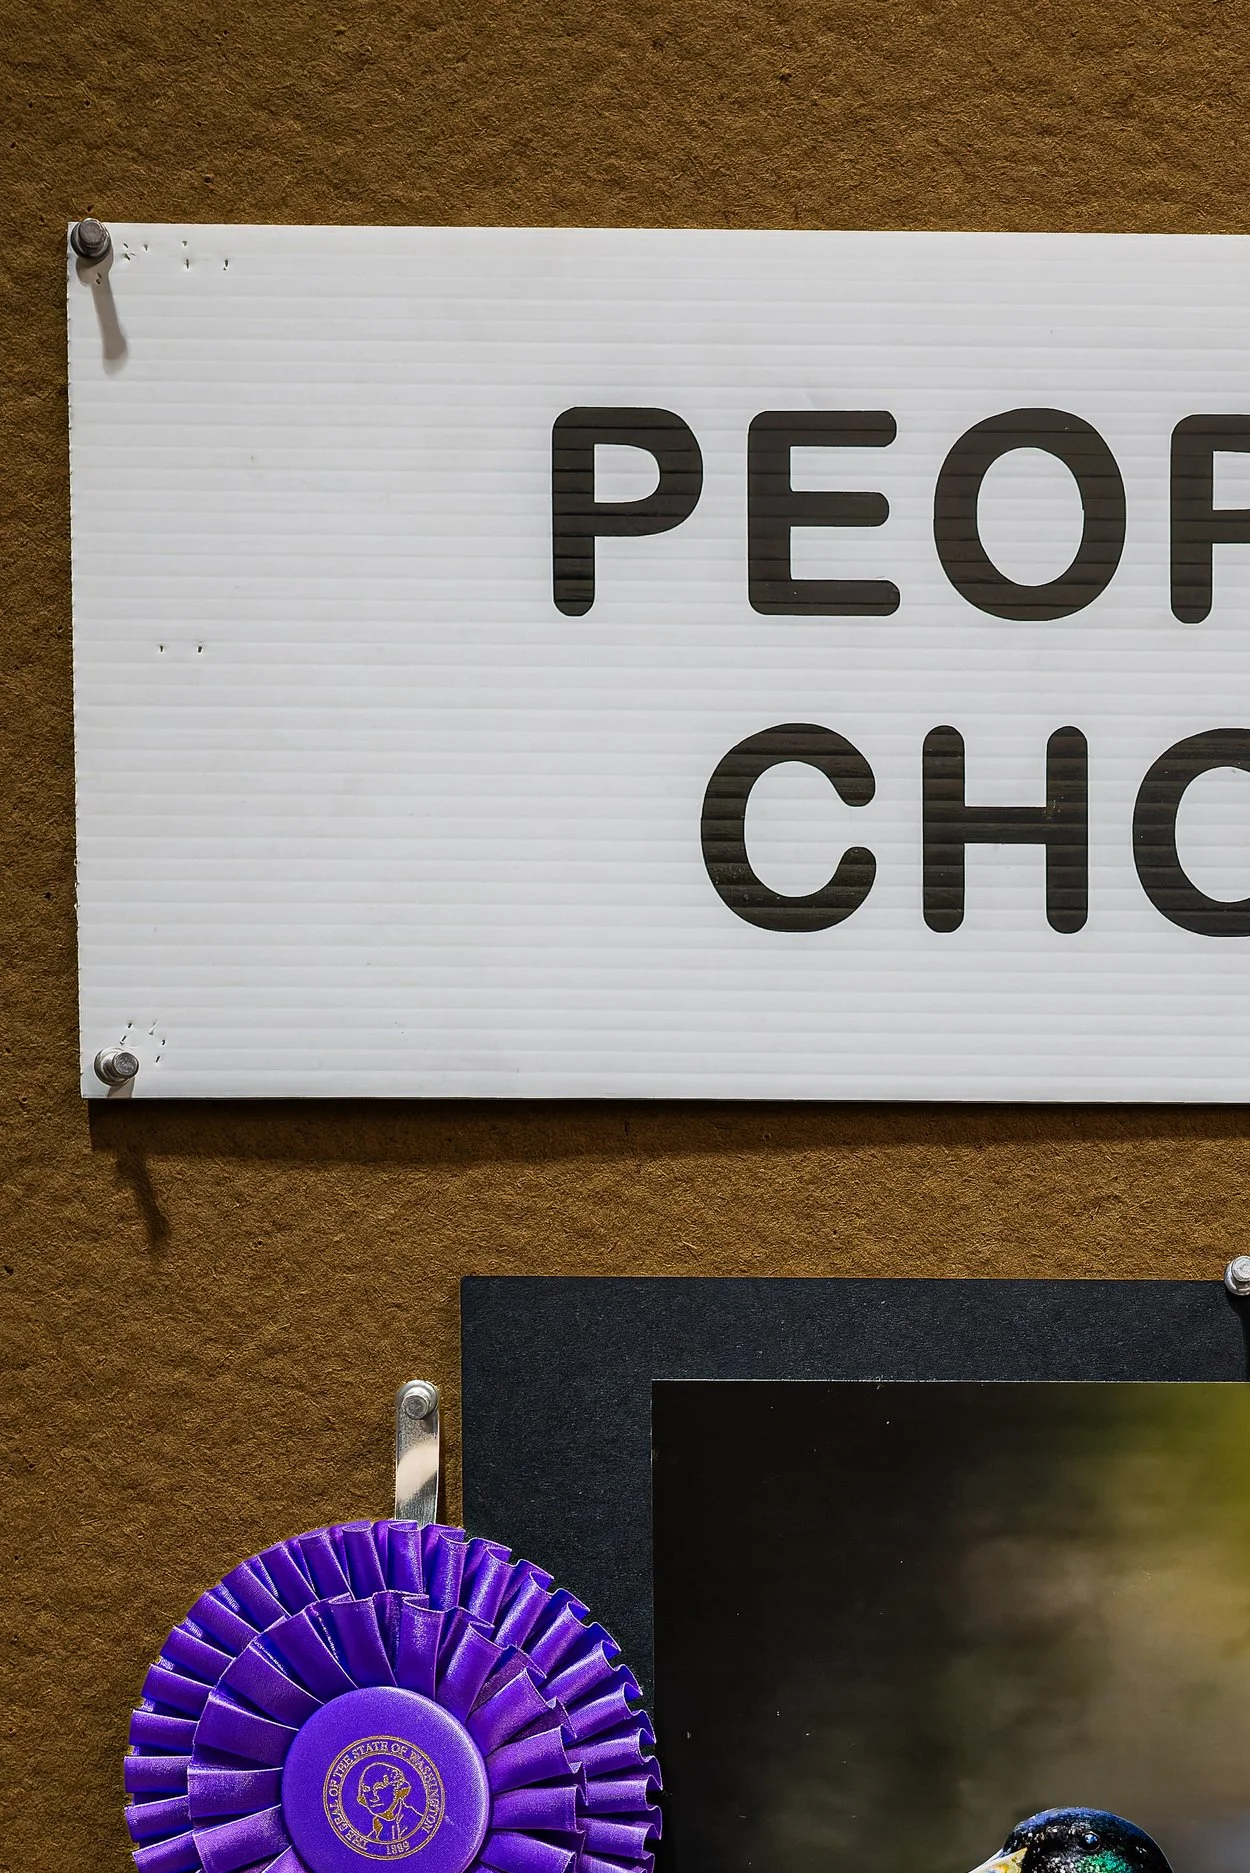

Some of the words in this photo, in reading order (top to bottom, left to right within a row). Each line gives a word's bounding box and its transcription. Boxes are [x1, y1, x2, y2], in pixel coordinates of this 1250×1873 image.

[352, 1741, 388, 1758] STATE
[391, 1743, 408, 1755] OF
[333, 1754, 353, 1777] THE
[329, 1780, 339, 1797] OF
[410, 1750, 439, 1833] WASHINGTON
